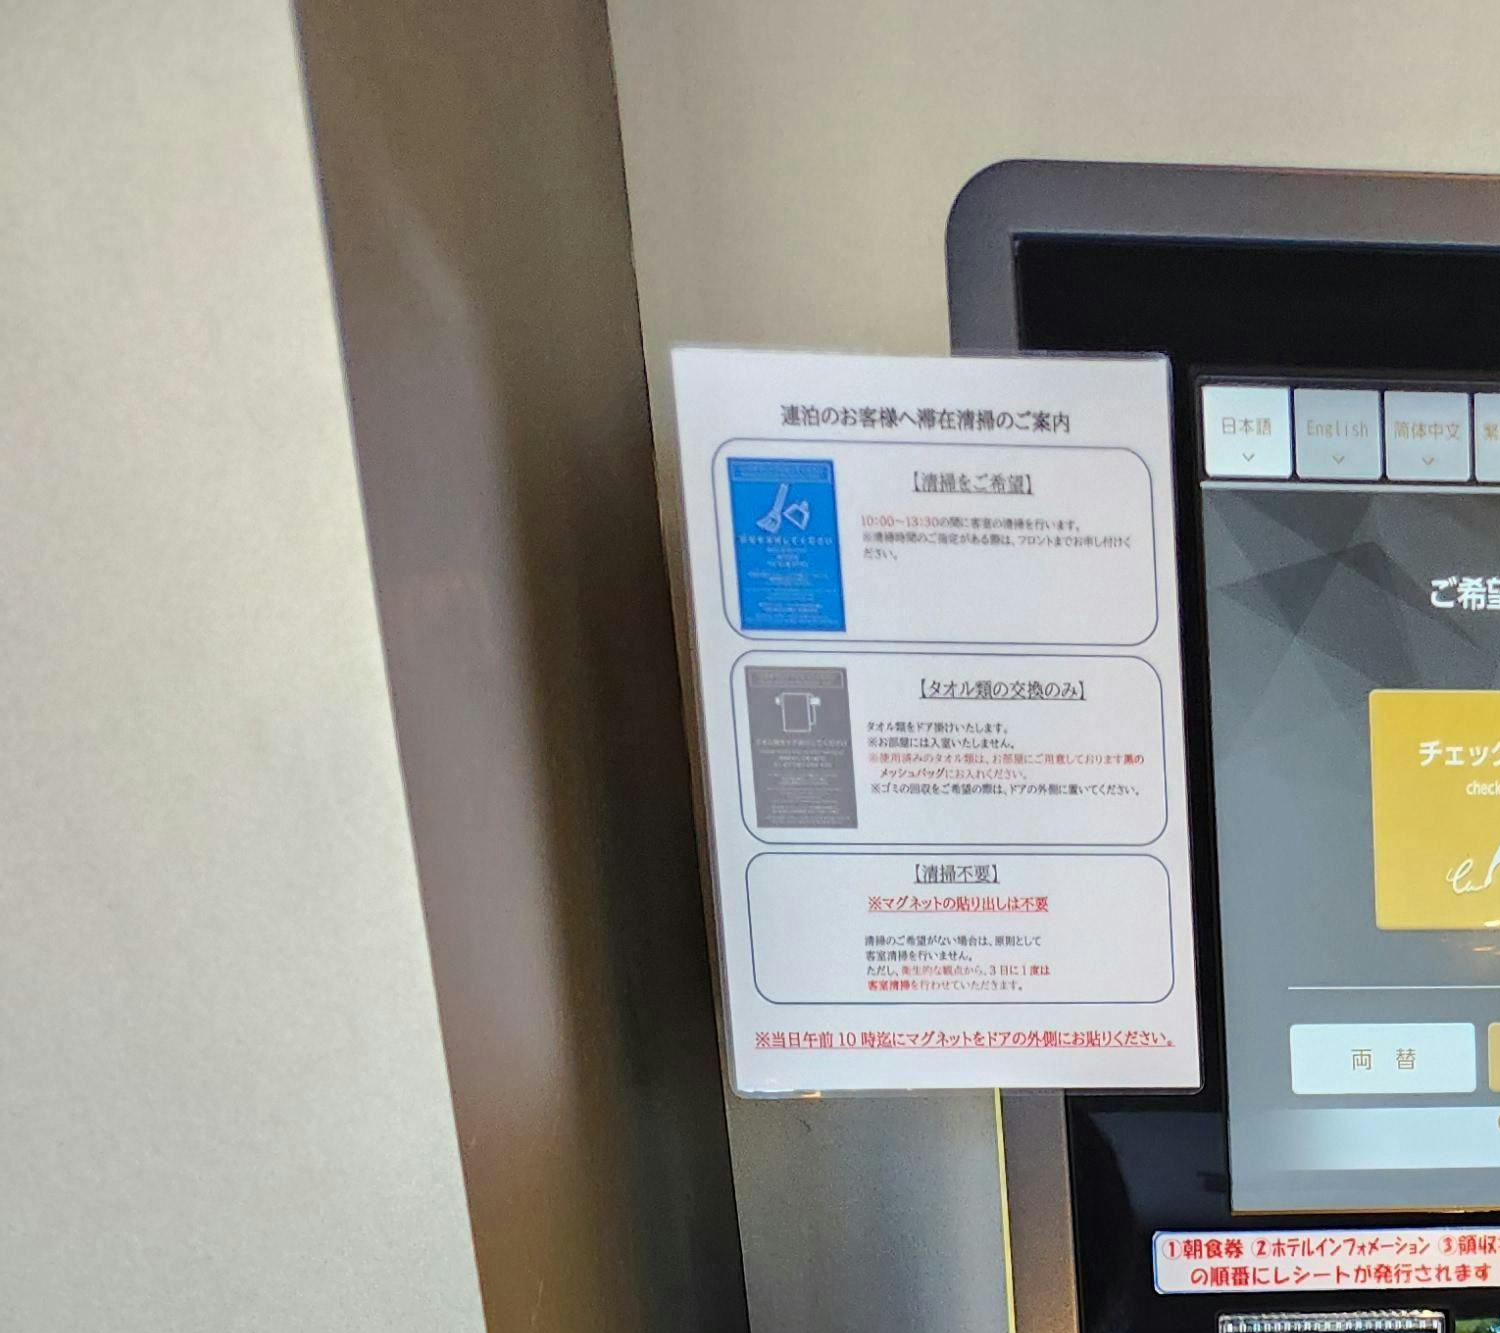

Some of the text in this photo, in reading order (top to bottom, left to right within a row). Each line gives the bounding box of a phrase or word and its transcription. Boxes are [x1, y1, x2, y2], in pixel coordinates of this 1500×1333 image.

[780, 404, 1071, 433] 連泊のお客様へ滞在清掃のご案内
[1221, 417, 1272, 436] 日本語
[1306, 417, 1370, 440] English
[1393, 420, 1461, 441] 简体中文
[919, 678, 1086, 701] 【タオル類の交換のみ】
[914, 863, 999, 884] 【清掃不要】
[1190, 1263, 1492, 1287] の順番にレシートが発行されます
